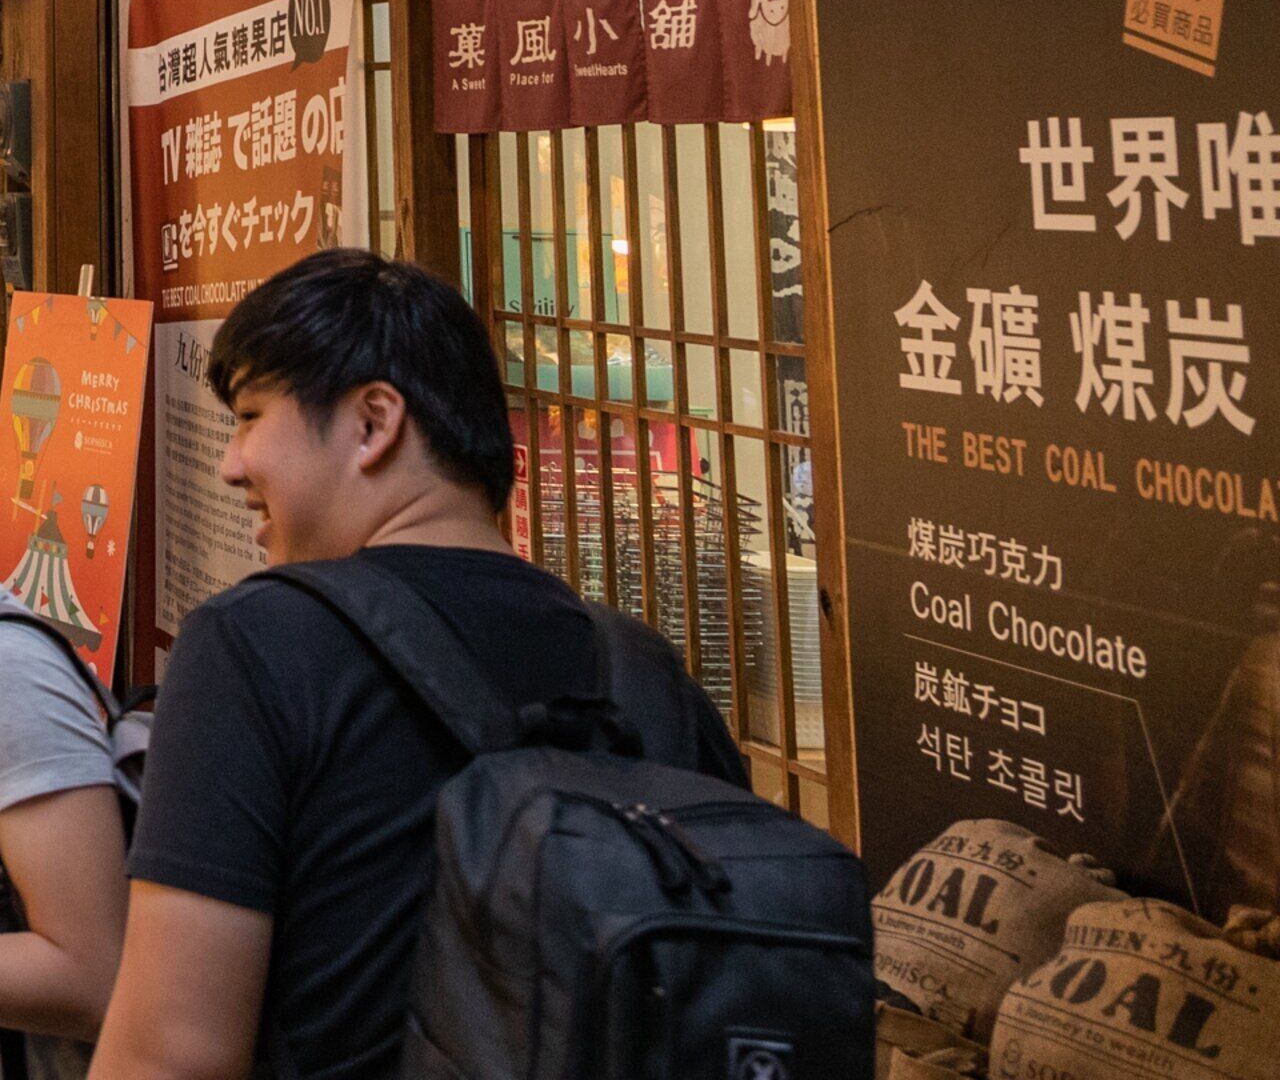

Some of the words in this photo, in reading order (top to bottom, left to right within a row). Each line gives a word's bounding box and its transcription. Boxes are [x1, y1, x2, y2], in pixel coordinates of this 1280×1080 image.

[452, 78, 459, 91] A
[462, 77, 487, 91] Sweet
[510, 72, 539, 87] Place
[541, 71, 555, 85] for
[161, 125, 182, 186] TV
[1018, 110, 1280, 246] 世界唯
[81, 370, 120, 392] MERRY
[893, 279, 1045, 409] 金礦
[1068, 290, 1257, 437] 煤炭
[901, 422, 949, 464] THE
[962, 431, 1027, 477] BEST
[1045, 444, 1118, 494] COAL
[1135, 458, 1280, 524] CHOCOLA
[907, 517, 1063, 591] 煤炭巧克力
[909, 581, 972, 632] Coal
[988, 600, 1148, 679] Chocolate
[916, 722, 974, 782] 석탄
[986, 748, 1086, 823] 초콜릿
[881, 857, 999, 936] OAL
[928, 927, 967, 950] wealth
[1022, 956, 1225, 1059] OAL
[1085, 1027, 1106, 1044] to
